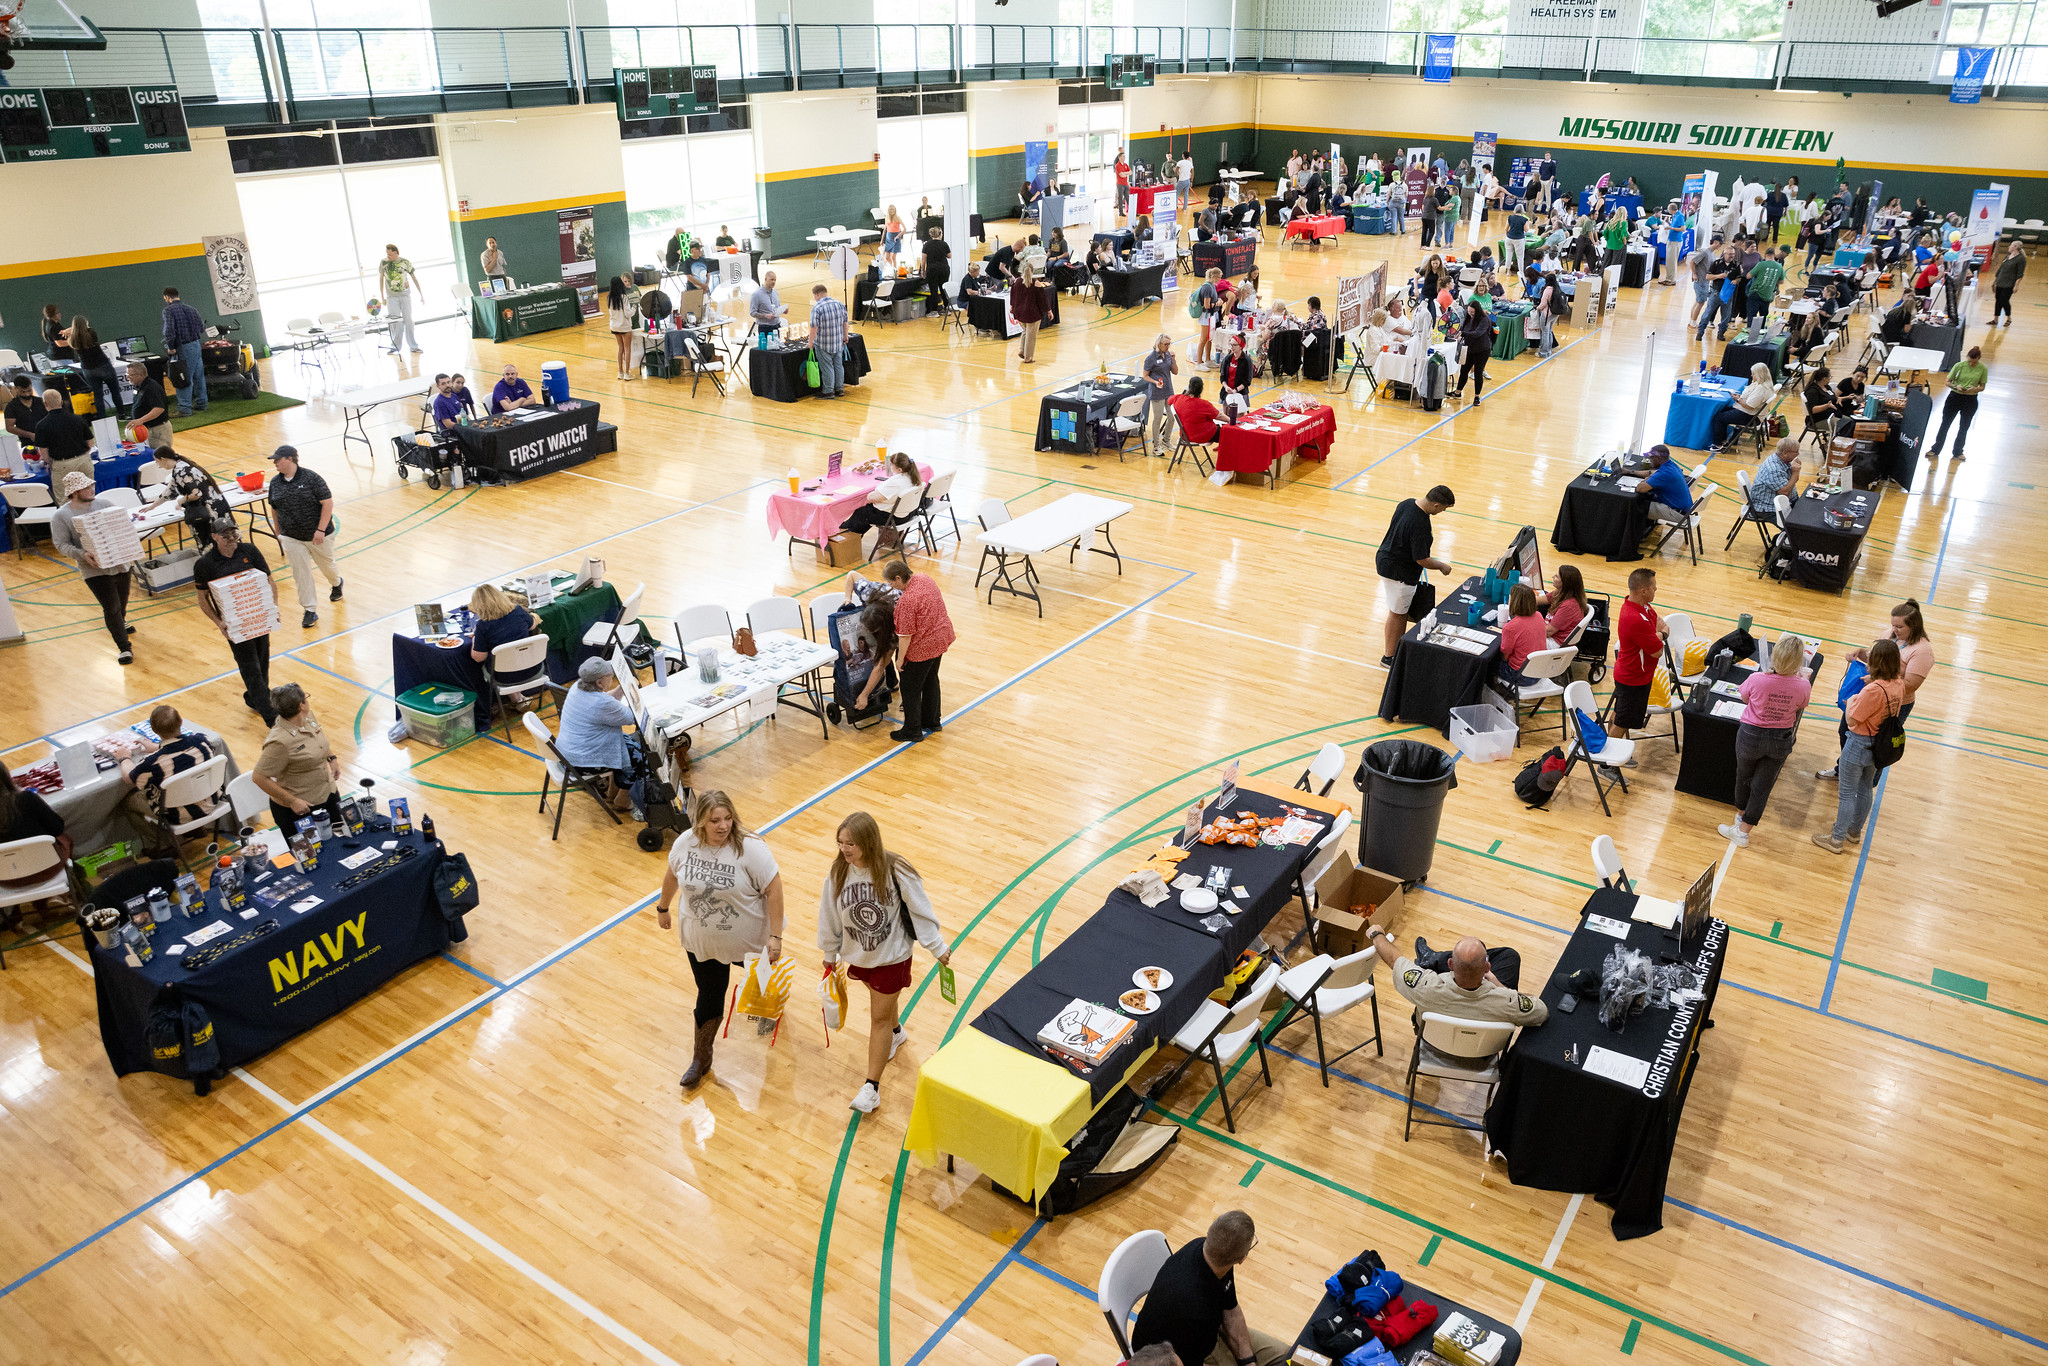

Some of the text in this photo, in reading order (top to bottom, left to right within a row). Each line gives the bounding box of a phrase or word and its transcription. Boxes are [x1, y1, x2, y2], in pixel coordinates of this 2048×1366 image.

[1530, 8, 1617, 19] HEALTH SYSEM
[623, 72, 647, 82] HOME
[693, 68, 716, 79] GUEST
[135, 89, 178, 105] GUEST
[1558, 116, 1834, 152] MISSOURI SOUTHERN
[28, 149, 57, 157] BONUS
[144, 142, 170, 150] BONUS
[206, 243, 216, 258] OLD
[225, 237, 249, 253] TATTOO
[1225, 243, 1255, 256] TOWNEPLACE
[518, 303, 533, 311] George
[533, 300, 556, 309] Washington
[518, 308, 536, 316] National
[536, 304, 558, 312] Monument
[509, 424, 588, 467] FIRST WATCH
[521, 446, 582, 472] BREAKFAST BRUNCH LUNCH
[685, 851, 736, 875] Kingdom
[684, 865, 735, 888] Workers
[268, 911, 367, 993] NAVY
[273, 944, 382, 1007] 1-800-USA-NAVY navy.com
[1642, 1039, 1681, 1099] CHRISTIAN
[1668, 999, 1698, 1040] COUNT
